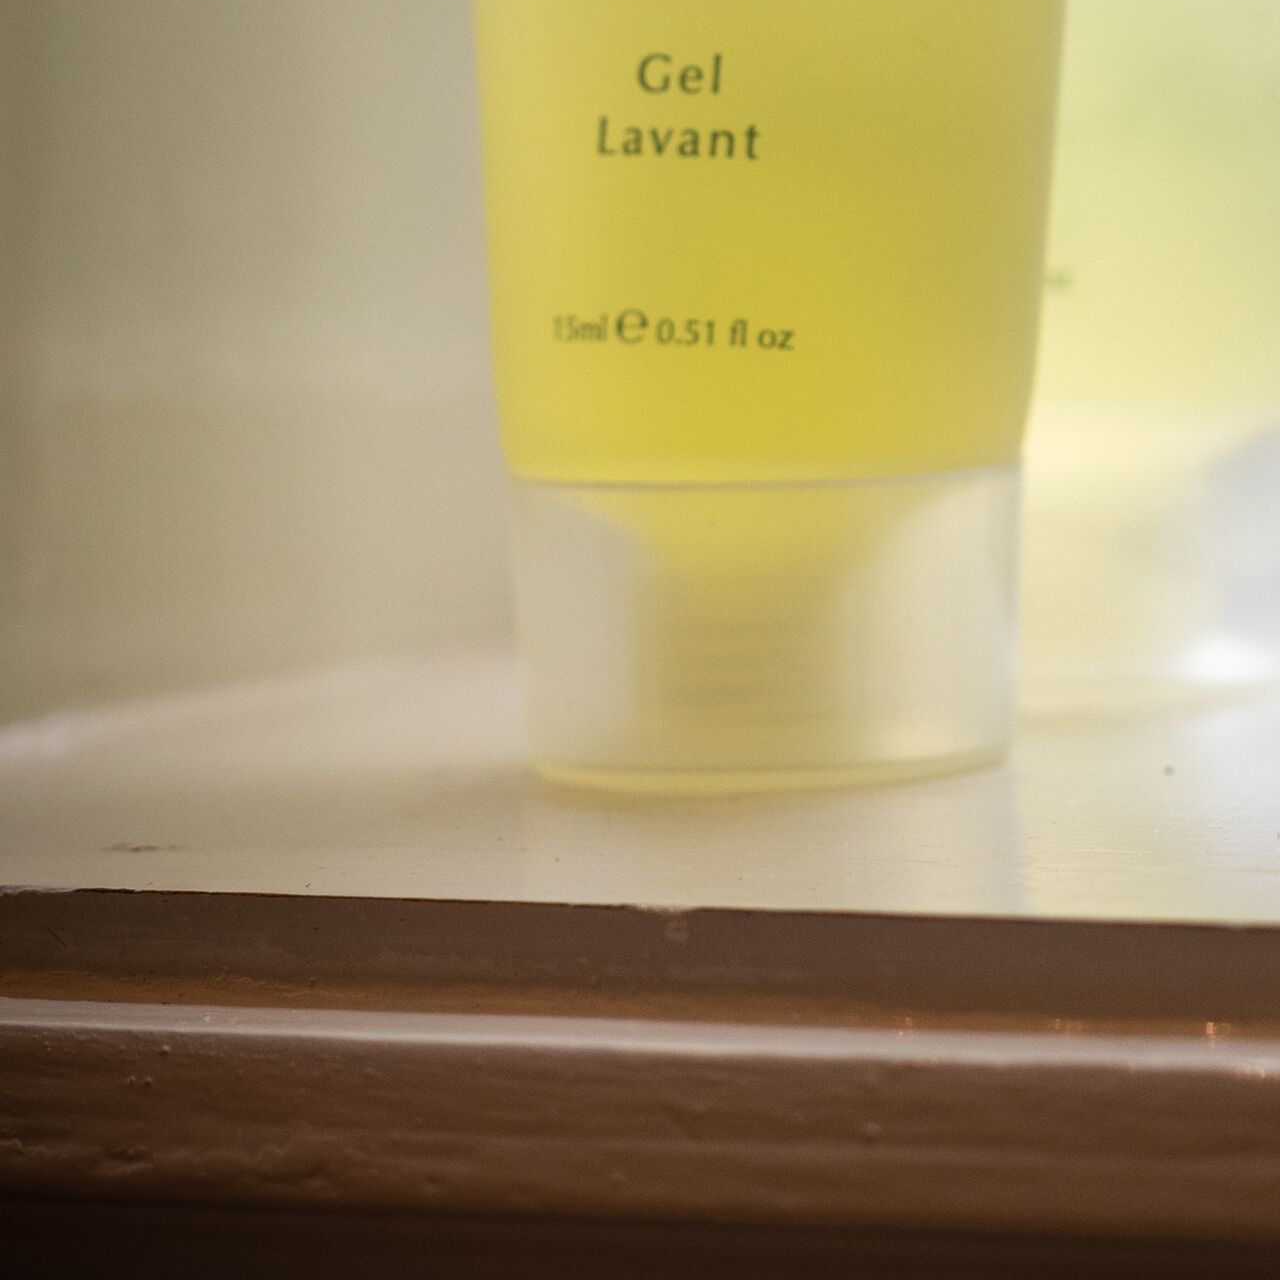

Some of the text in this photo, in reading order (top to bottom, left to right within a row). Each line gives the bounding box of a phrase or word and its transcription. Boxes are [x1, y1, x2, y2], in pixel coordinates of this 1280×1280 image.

[636, 52, 723, 95] Gel
[596, 116, 761, 161] Lavant
[553, 313, 609, 342] 15ml
[656, 317, 715, 346] 0.51
[757, 327, 796, 350] oz
